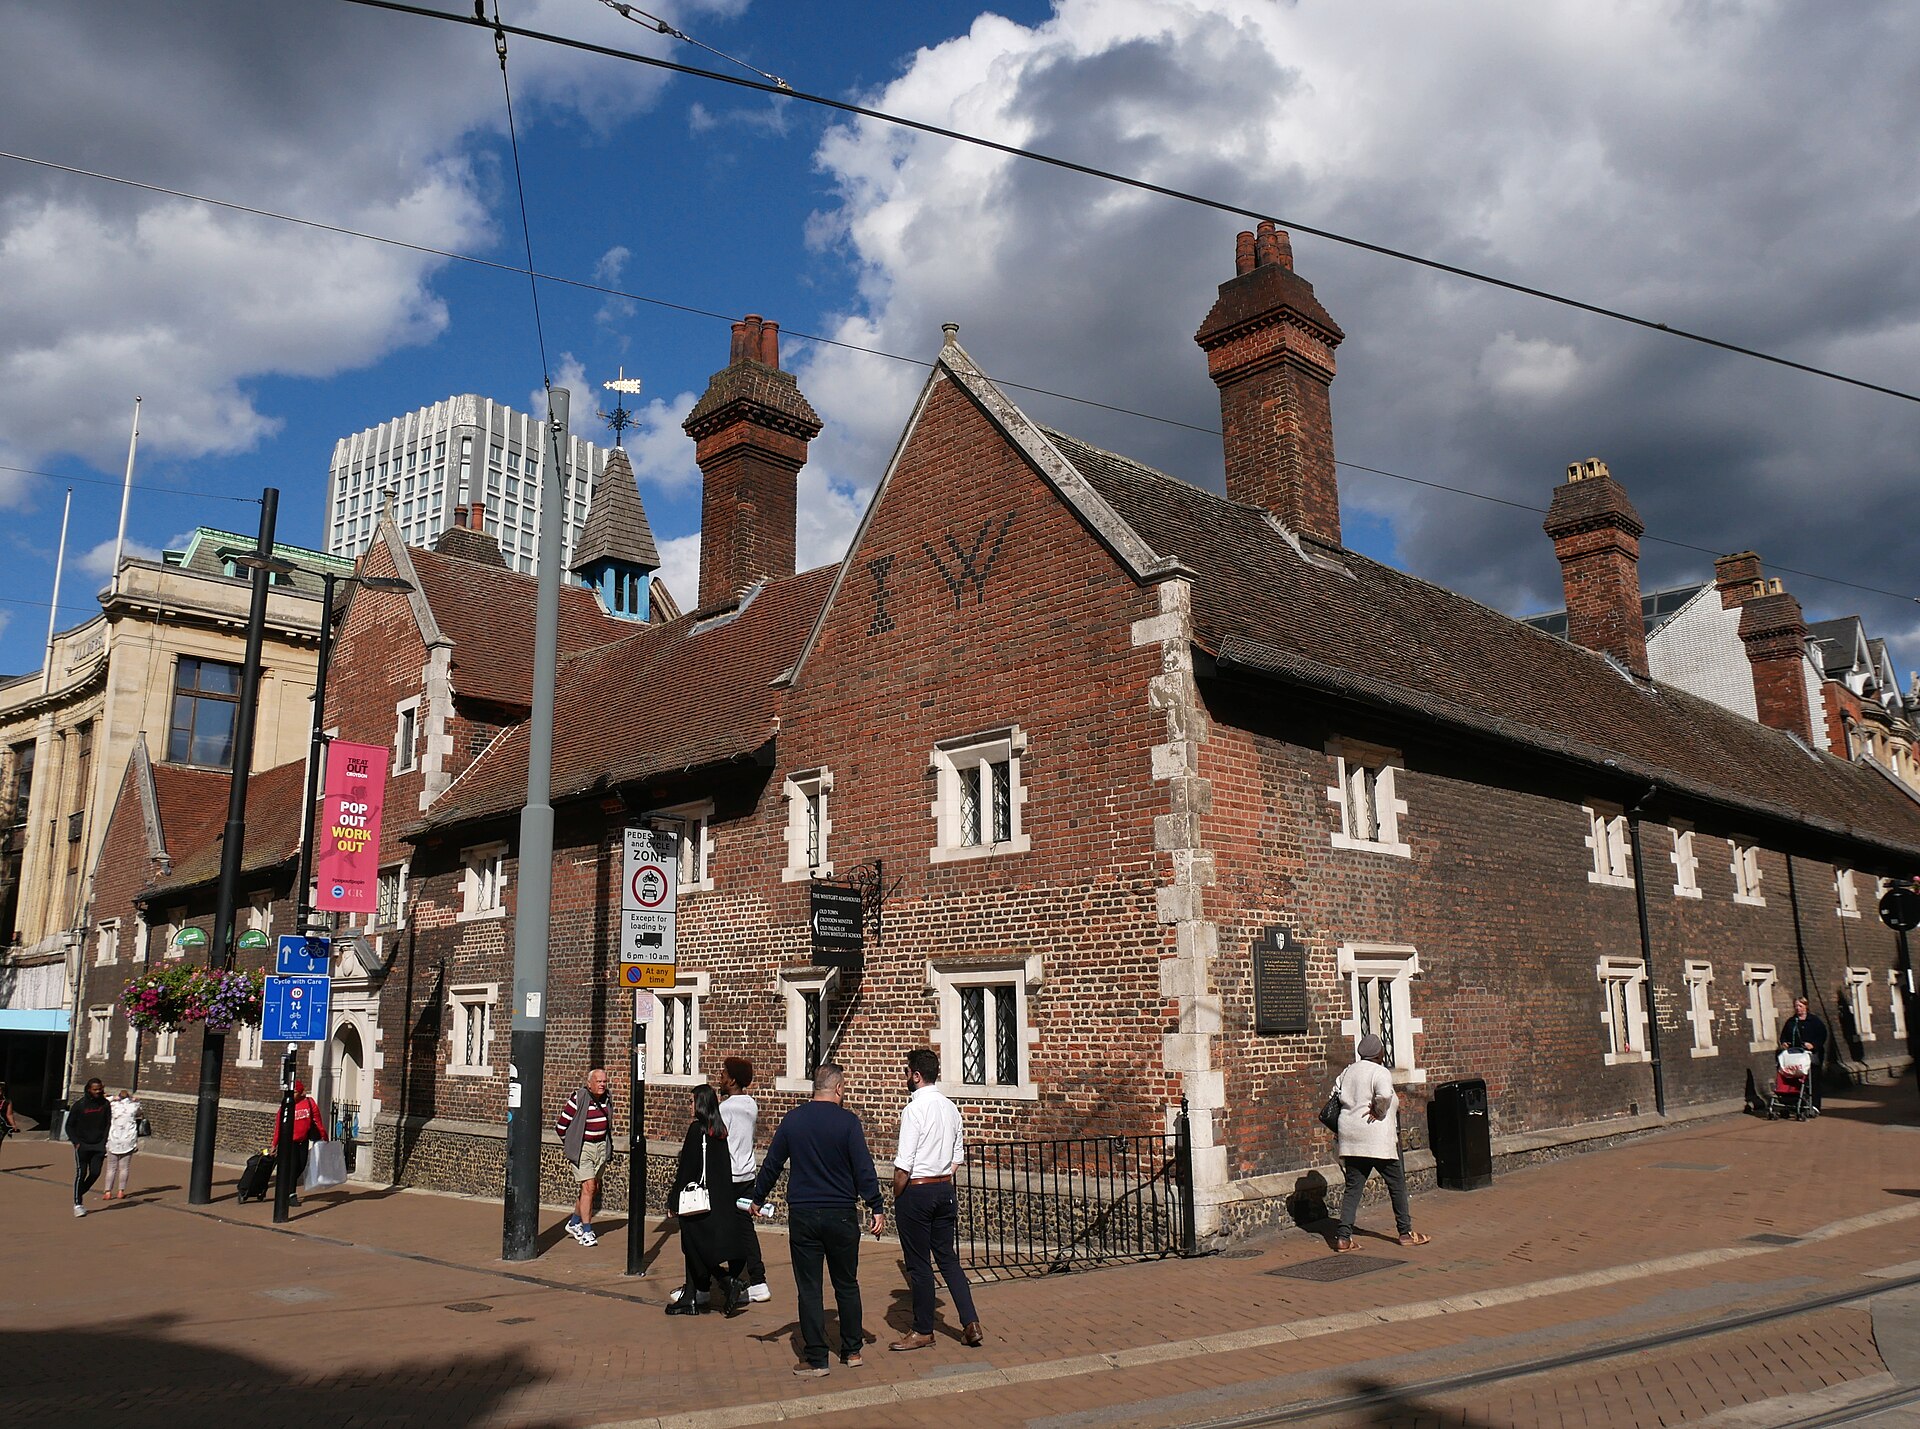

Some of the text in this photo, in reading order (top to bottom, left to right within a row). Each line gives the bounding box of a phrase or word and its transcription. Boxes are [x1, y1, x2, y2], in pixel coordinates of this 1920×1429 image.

[347, 757, 368, 766] TREAT
[346, 763, 368, 774] OUT
[340, 801, 368, 814] POP
[339, 814, 367, 827] OUT
[331, 826, 372, 841] WORK
[627, 831, 675, 842] PEDESTRIAN
[337, 840, 365, 853] OUT
[646, 841, 670, 850] CYCLE
[633, 850, 667, 863] ZONE
[631, 914, 667, 923] Except for
[630, 922, 667, 932] loading by
[645, 967, 668, 977] At any
[649, 975, 665, 983] time
